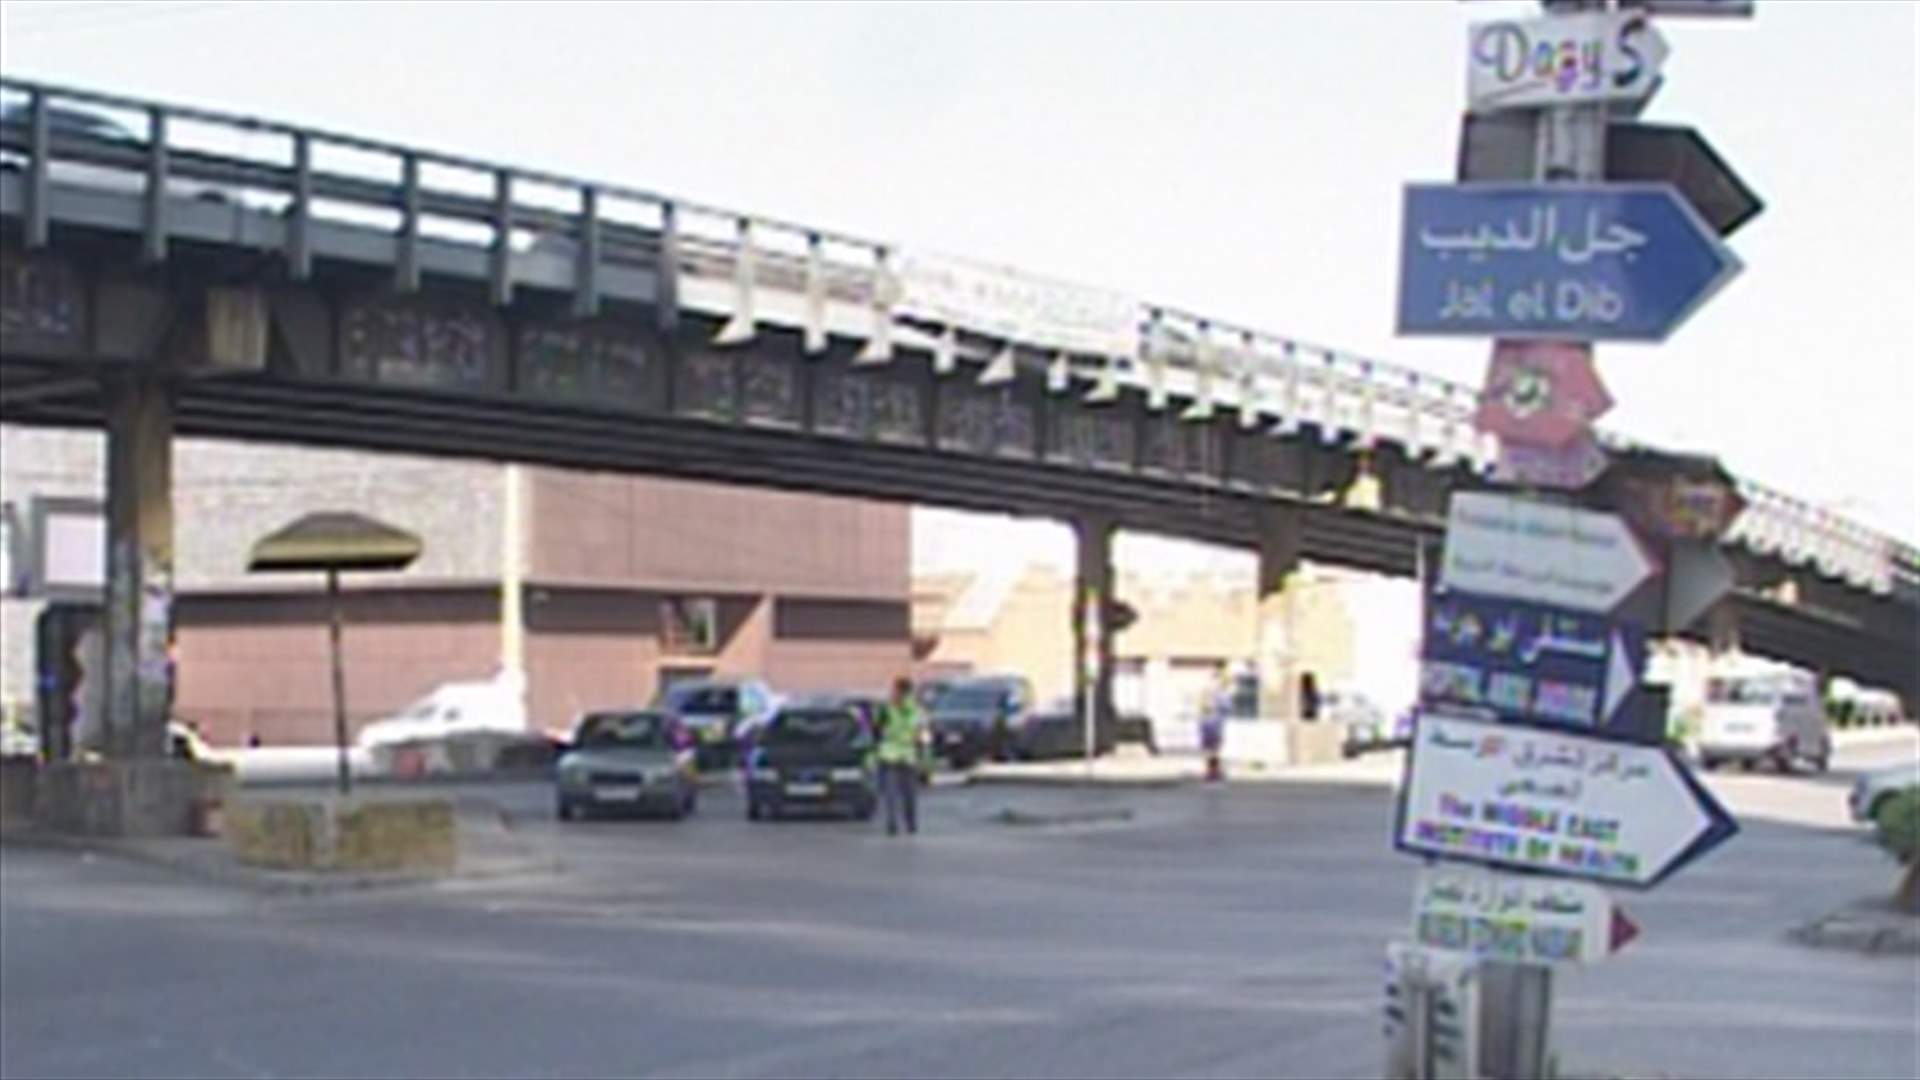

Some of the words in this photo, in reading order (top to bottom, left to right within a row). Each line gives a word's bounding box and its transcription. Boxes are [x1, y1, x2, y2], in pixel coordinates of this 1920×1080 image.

[1421, 205, 1555, 262] الديب
[1558, 208, 1647, 262] جل
[1507, 280, 1546, 320] el
[1555, 281, 1624, 322] Dib
